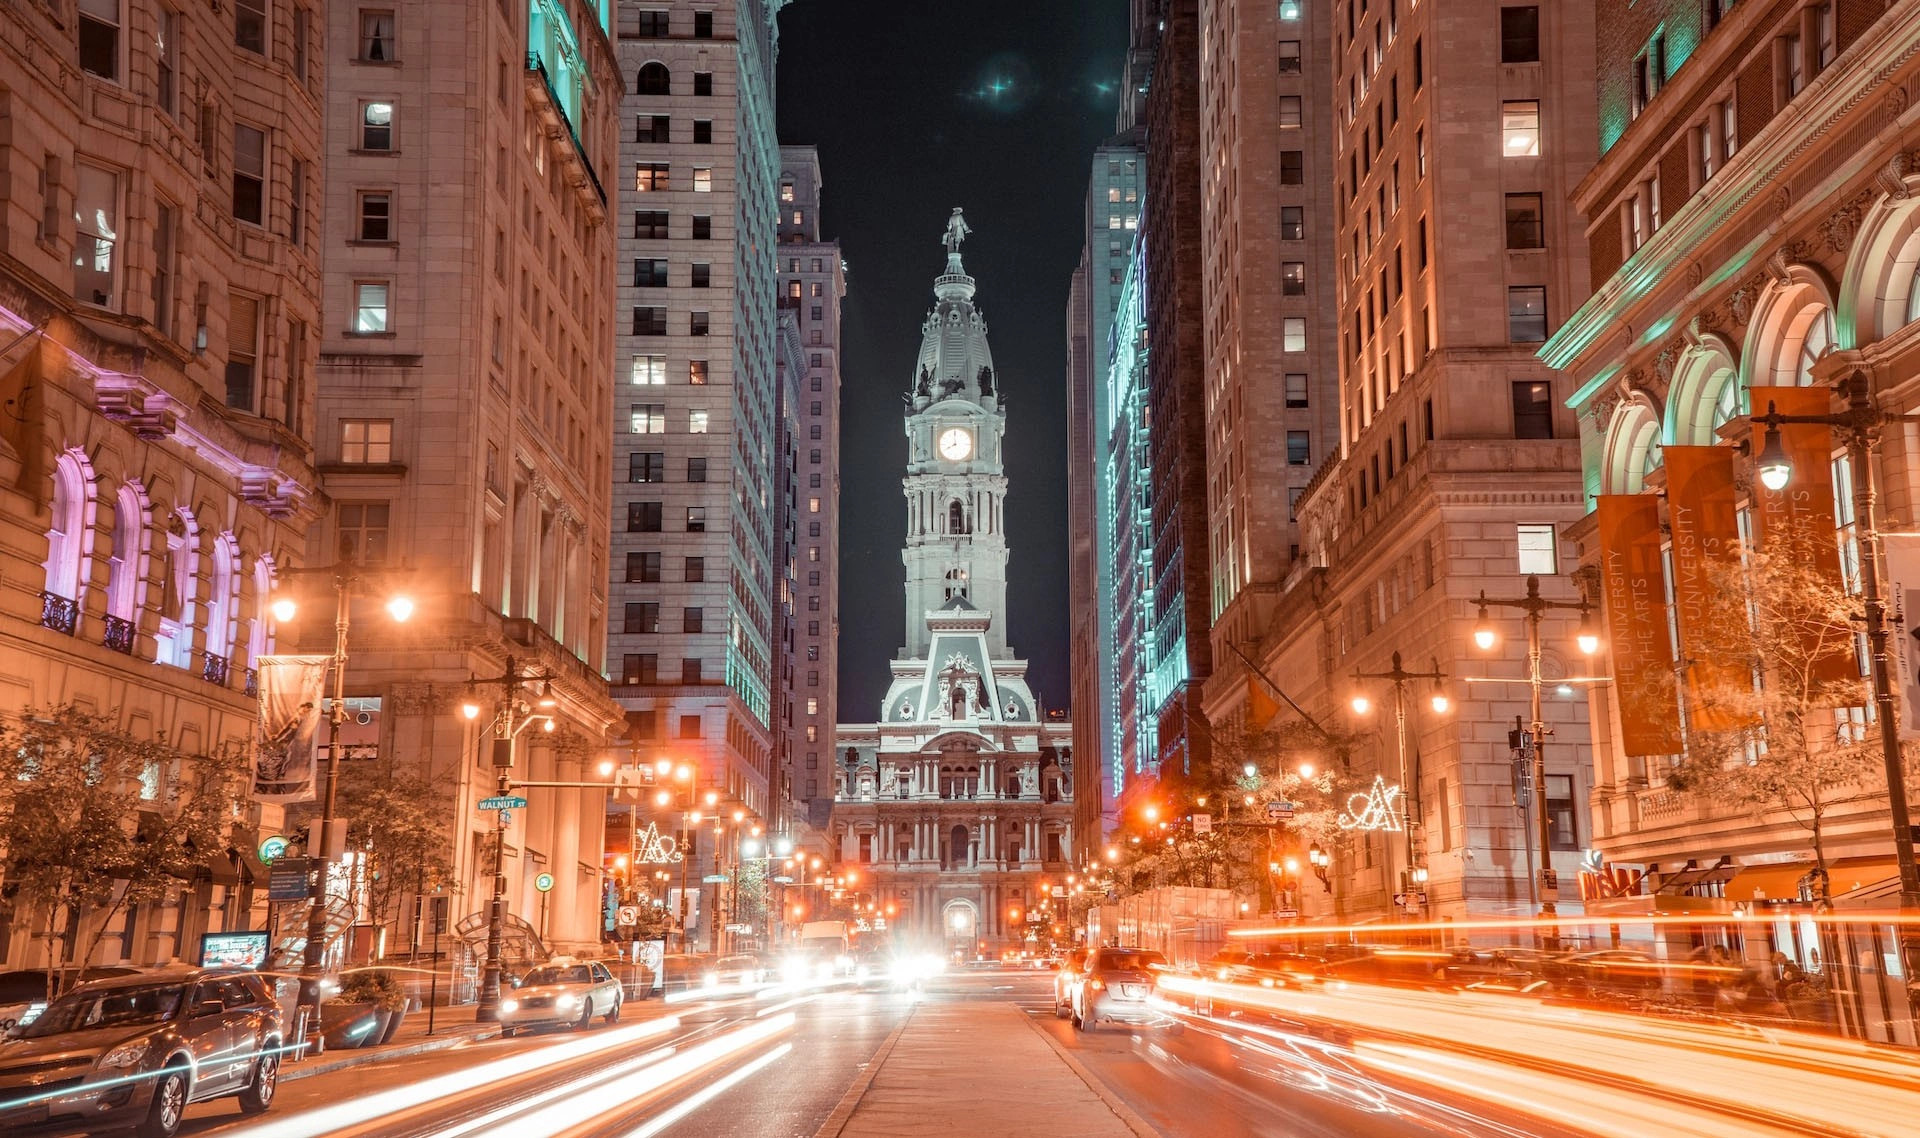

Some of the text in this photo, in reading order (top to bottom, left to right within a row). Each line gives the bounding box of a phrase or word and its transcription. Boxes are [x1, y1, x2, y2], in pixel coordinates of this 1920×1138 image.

[1675, 504, 1701, 620] UNIVERSITY
[1607, 549, 1635, 698] THE UNIVERSITY
[1631, 577, 1652, 624] ARTS
[1637, 630, 1656, 664] THE
[479, 800, 515, 809] WALNUT
